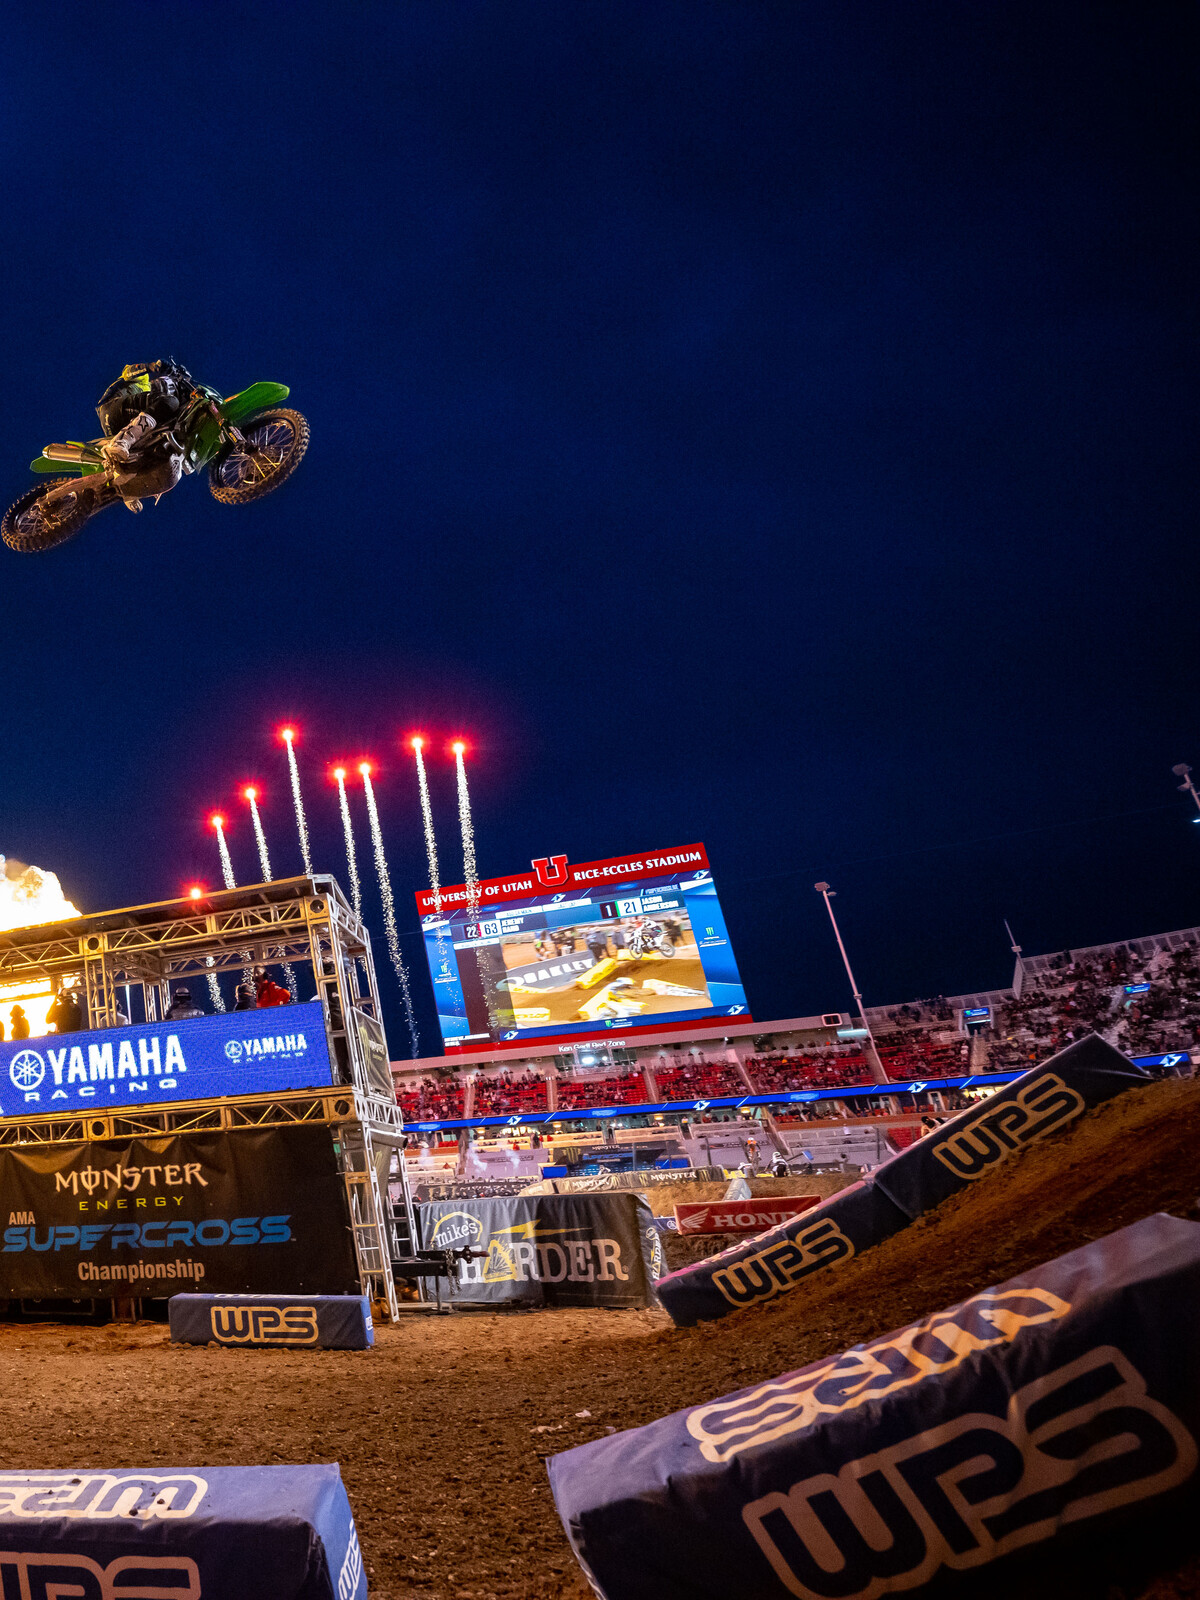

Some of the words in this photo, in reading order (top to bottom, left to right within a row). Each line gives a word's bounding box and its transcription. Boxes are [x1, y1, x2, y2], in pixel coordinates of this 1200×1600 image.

[531, 854, 569, 888] U
[573, 861, 644, 881] RICE-ECCLES
[645, 851, 702, 869] STADIUM
[422, 888, 483, 906] UNIVERSITY
[485, 886, 500, 896] OF
[502, 880, 533, 893] UTAH
[623, 902, 637, 914] 21
[484, 923, 498, 935] 63
[243, 1034, 308, 1056] YAMAHA
[47, 1034, 187, 1085] YAMAHA
[24, 1079, 178, 1102] RACING
[932, 1072, 1086, 1180] WPS
[54, 1162, 209, 1196] MONSTER
[651, 1171, 697, 1182] MONSTER
[79, 1196, 185, 1211] ENERGY
[8, 1211, 36, 1226] AMA
[711, 1211, 799, 1228] HOND
[2, 1215, 292, 1252] SUPERCROSS
[435, 1220, 479, 1248] mike's
[78, 1258, 205, 1283] Championship
[458, 1238, 630, 1285] HARDER
[711, 1217, 856, 1308] WPS
[211, 1306, 319, 1344] WPS
[741, 1344, 1199, 1600] WPS
